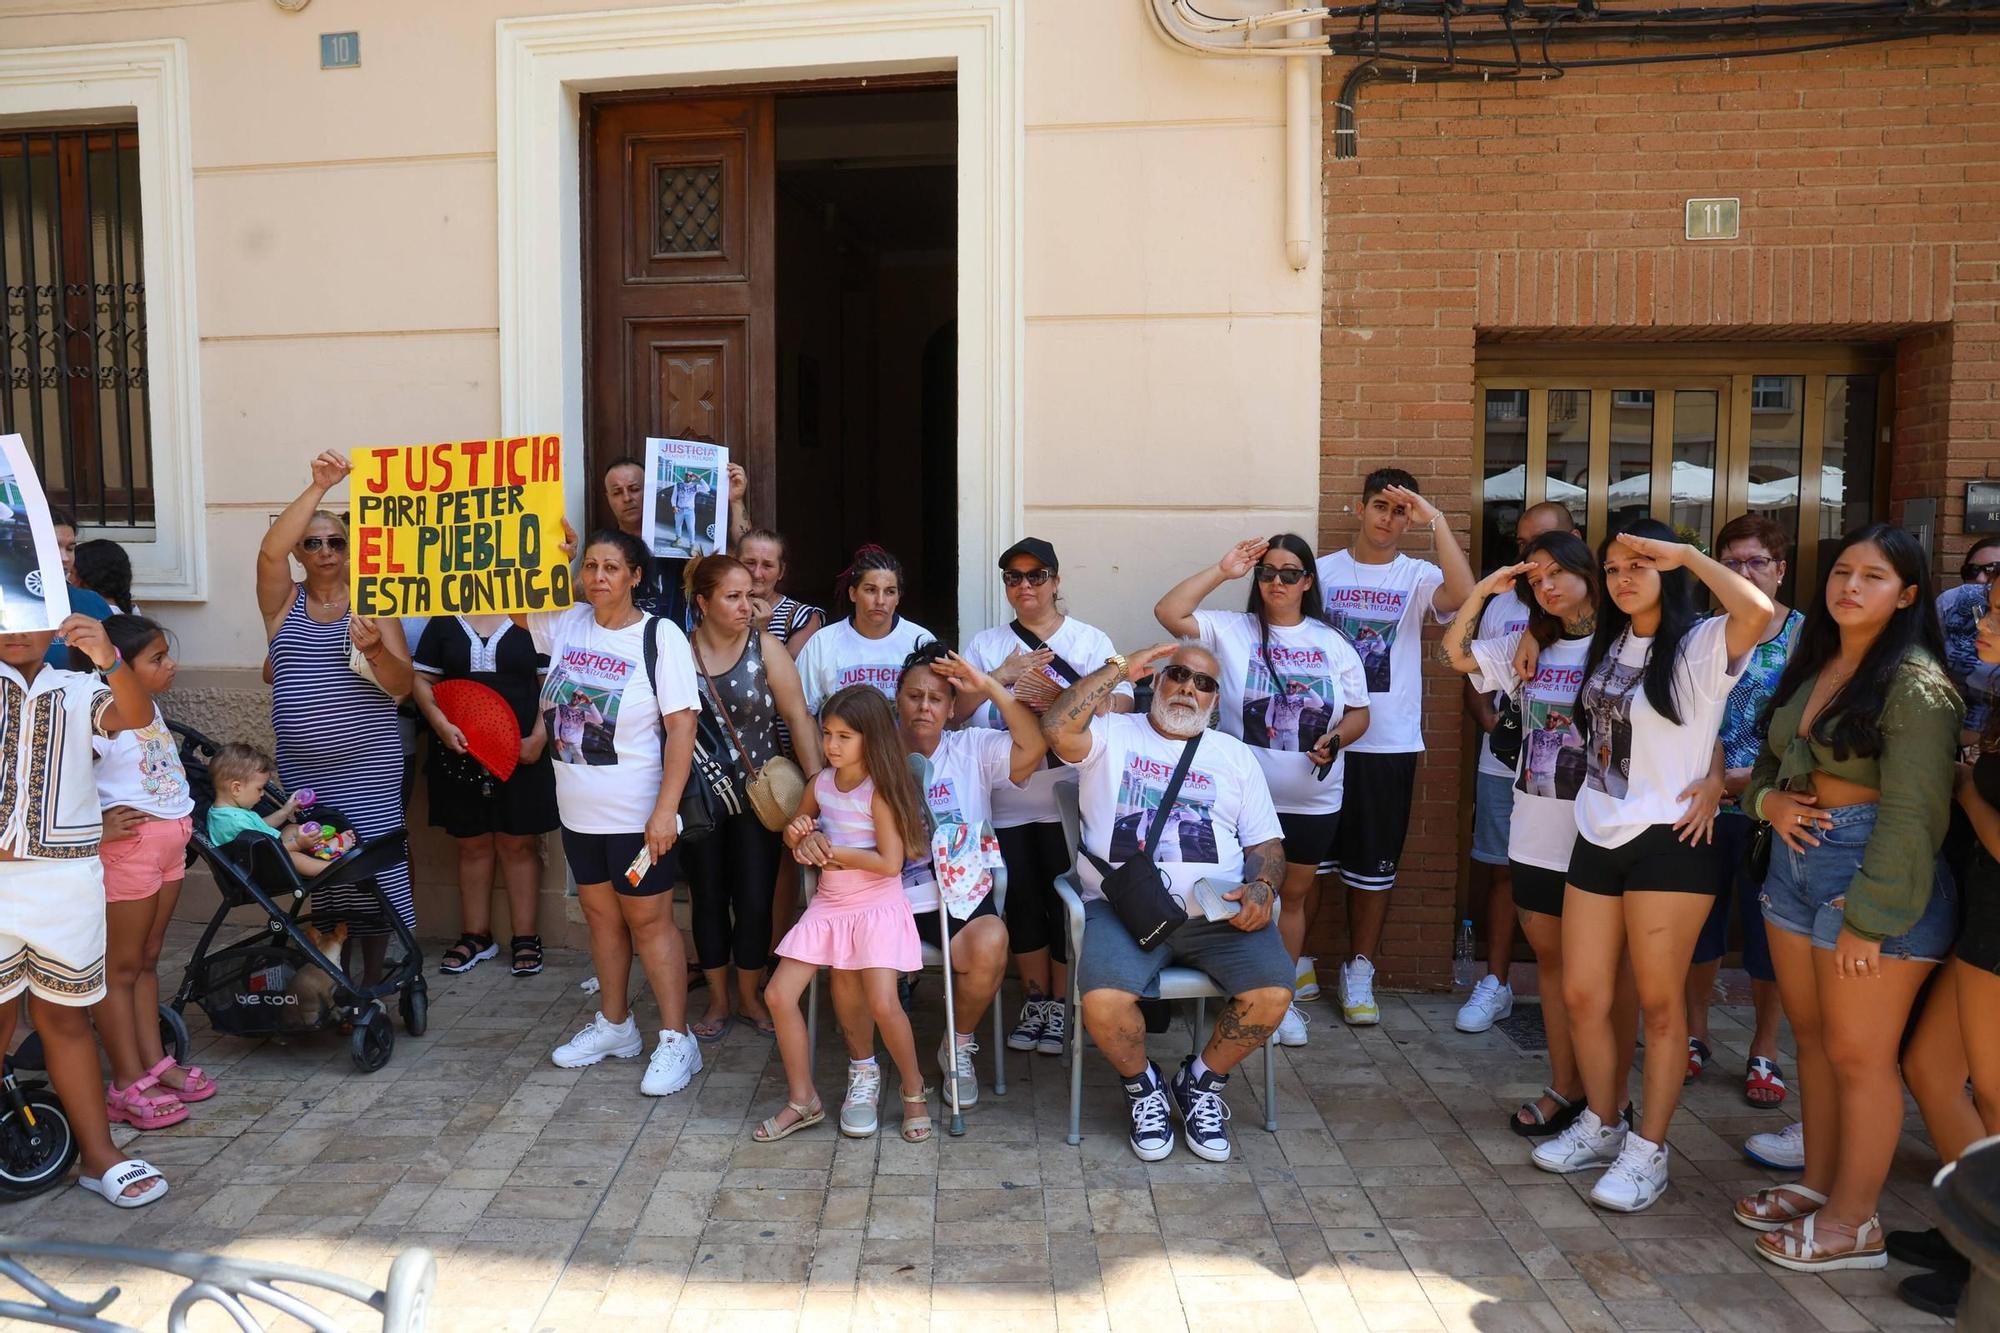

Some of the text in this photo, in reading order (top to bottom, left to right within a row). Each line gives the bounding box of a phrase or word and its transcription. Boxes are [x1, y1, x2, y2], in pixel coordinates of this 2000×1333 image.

[332, 36, 350, 63] 10
[1704, 204, 1721, 233] 11
[661, 443, 715, 457] JUSTICIA
[366, 436, 560, 494] JUSTICIA
[359, 485, 525, 527] PARA PETER
[358, 513, 541, 575] EL PUEBLO
[356, 564, 571, 617] ESTA CONTIGO
[1331, 589, 1401, 606] JUSTICIA
[1331, 602, 1361, 610] SIEMPRE
[1380, 605, 1399, 613] LADO
[562, 650, 626, 676] JUSTICIA
[600, 671, 619, 681] LADO
[1184, 782, 1207, 791] LADO
[235, 992, 299, 1006] be cool
